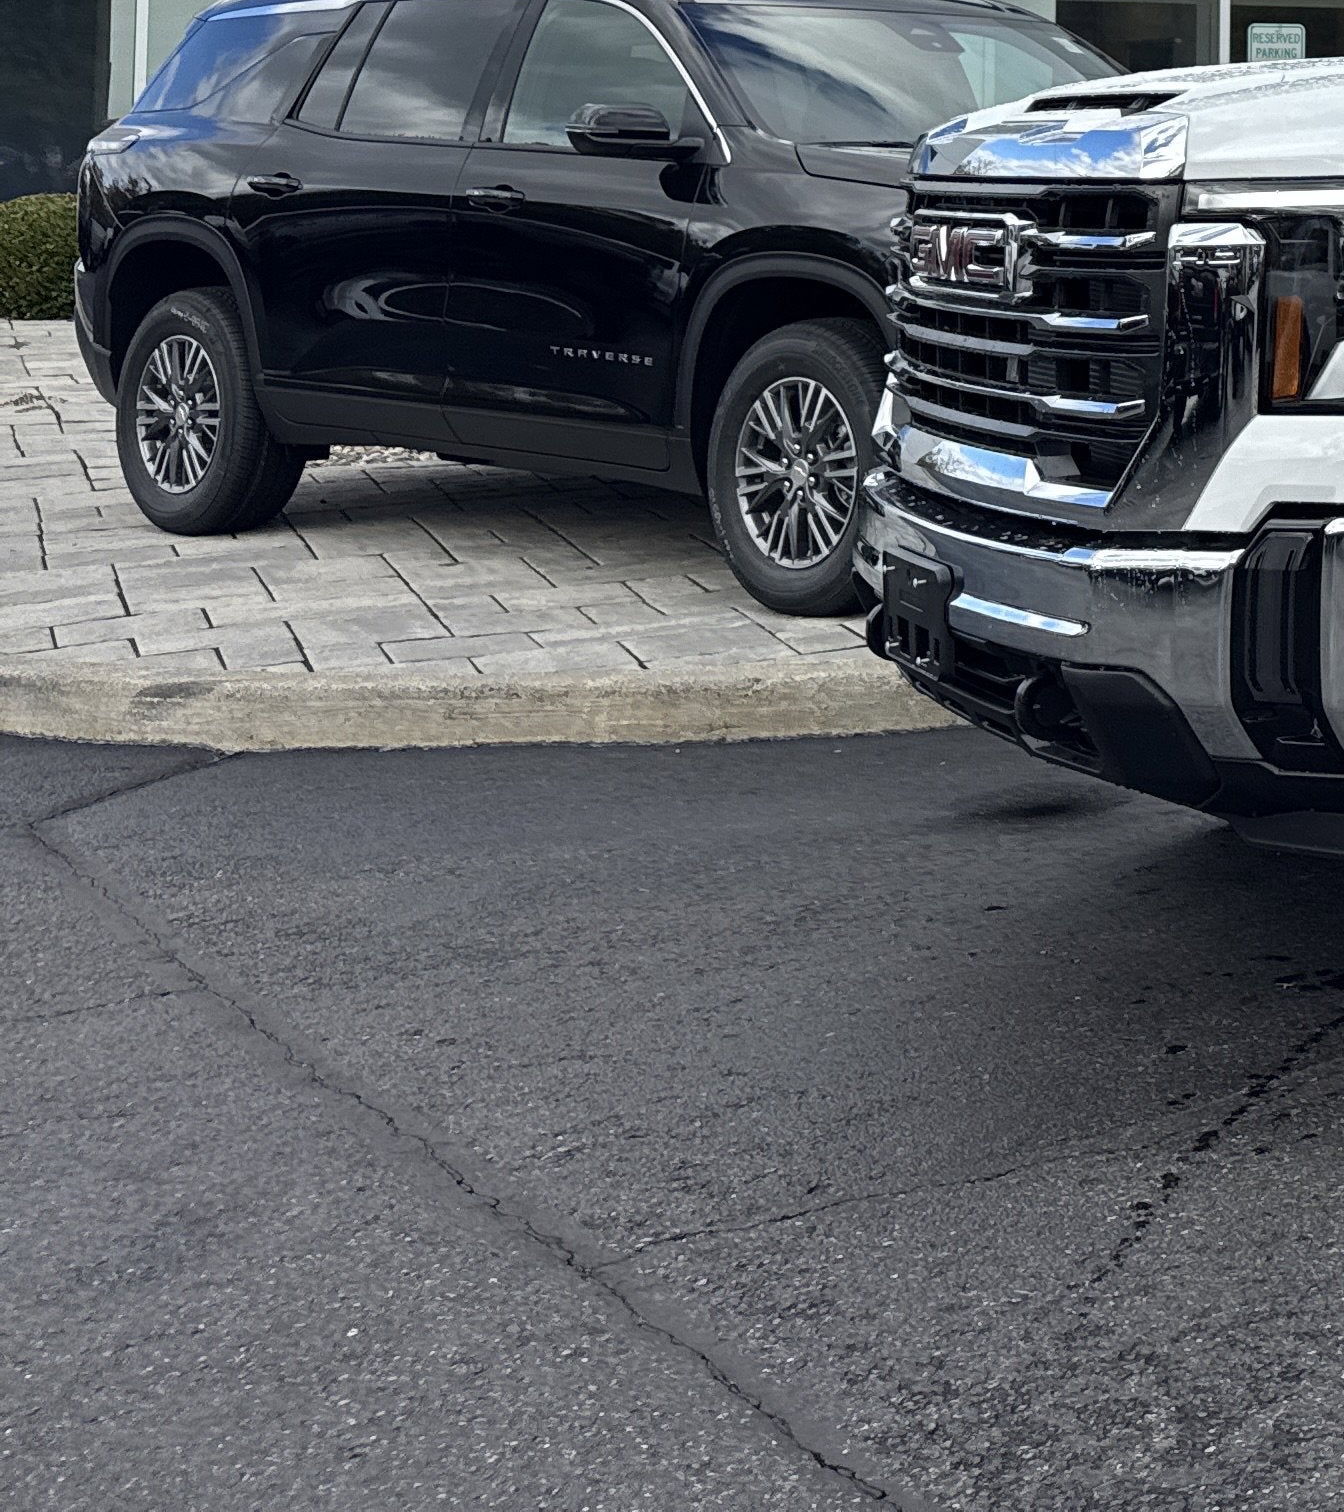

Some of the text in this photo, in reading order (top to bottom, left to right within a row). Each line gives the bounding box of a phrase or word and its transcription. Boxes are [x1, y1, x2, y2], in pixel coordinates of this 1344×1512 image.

[1252, 32, 1301, 44] RESERVED
[1255, 47, 1298, 59] PARKING
[910, 224, 1006, 286] GMC
[549, 345, 654, 367] TRAVERSE
